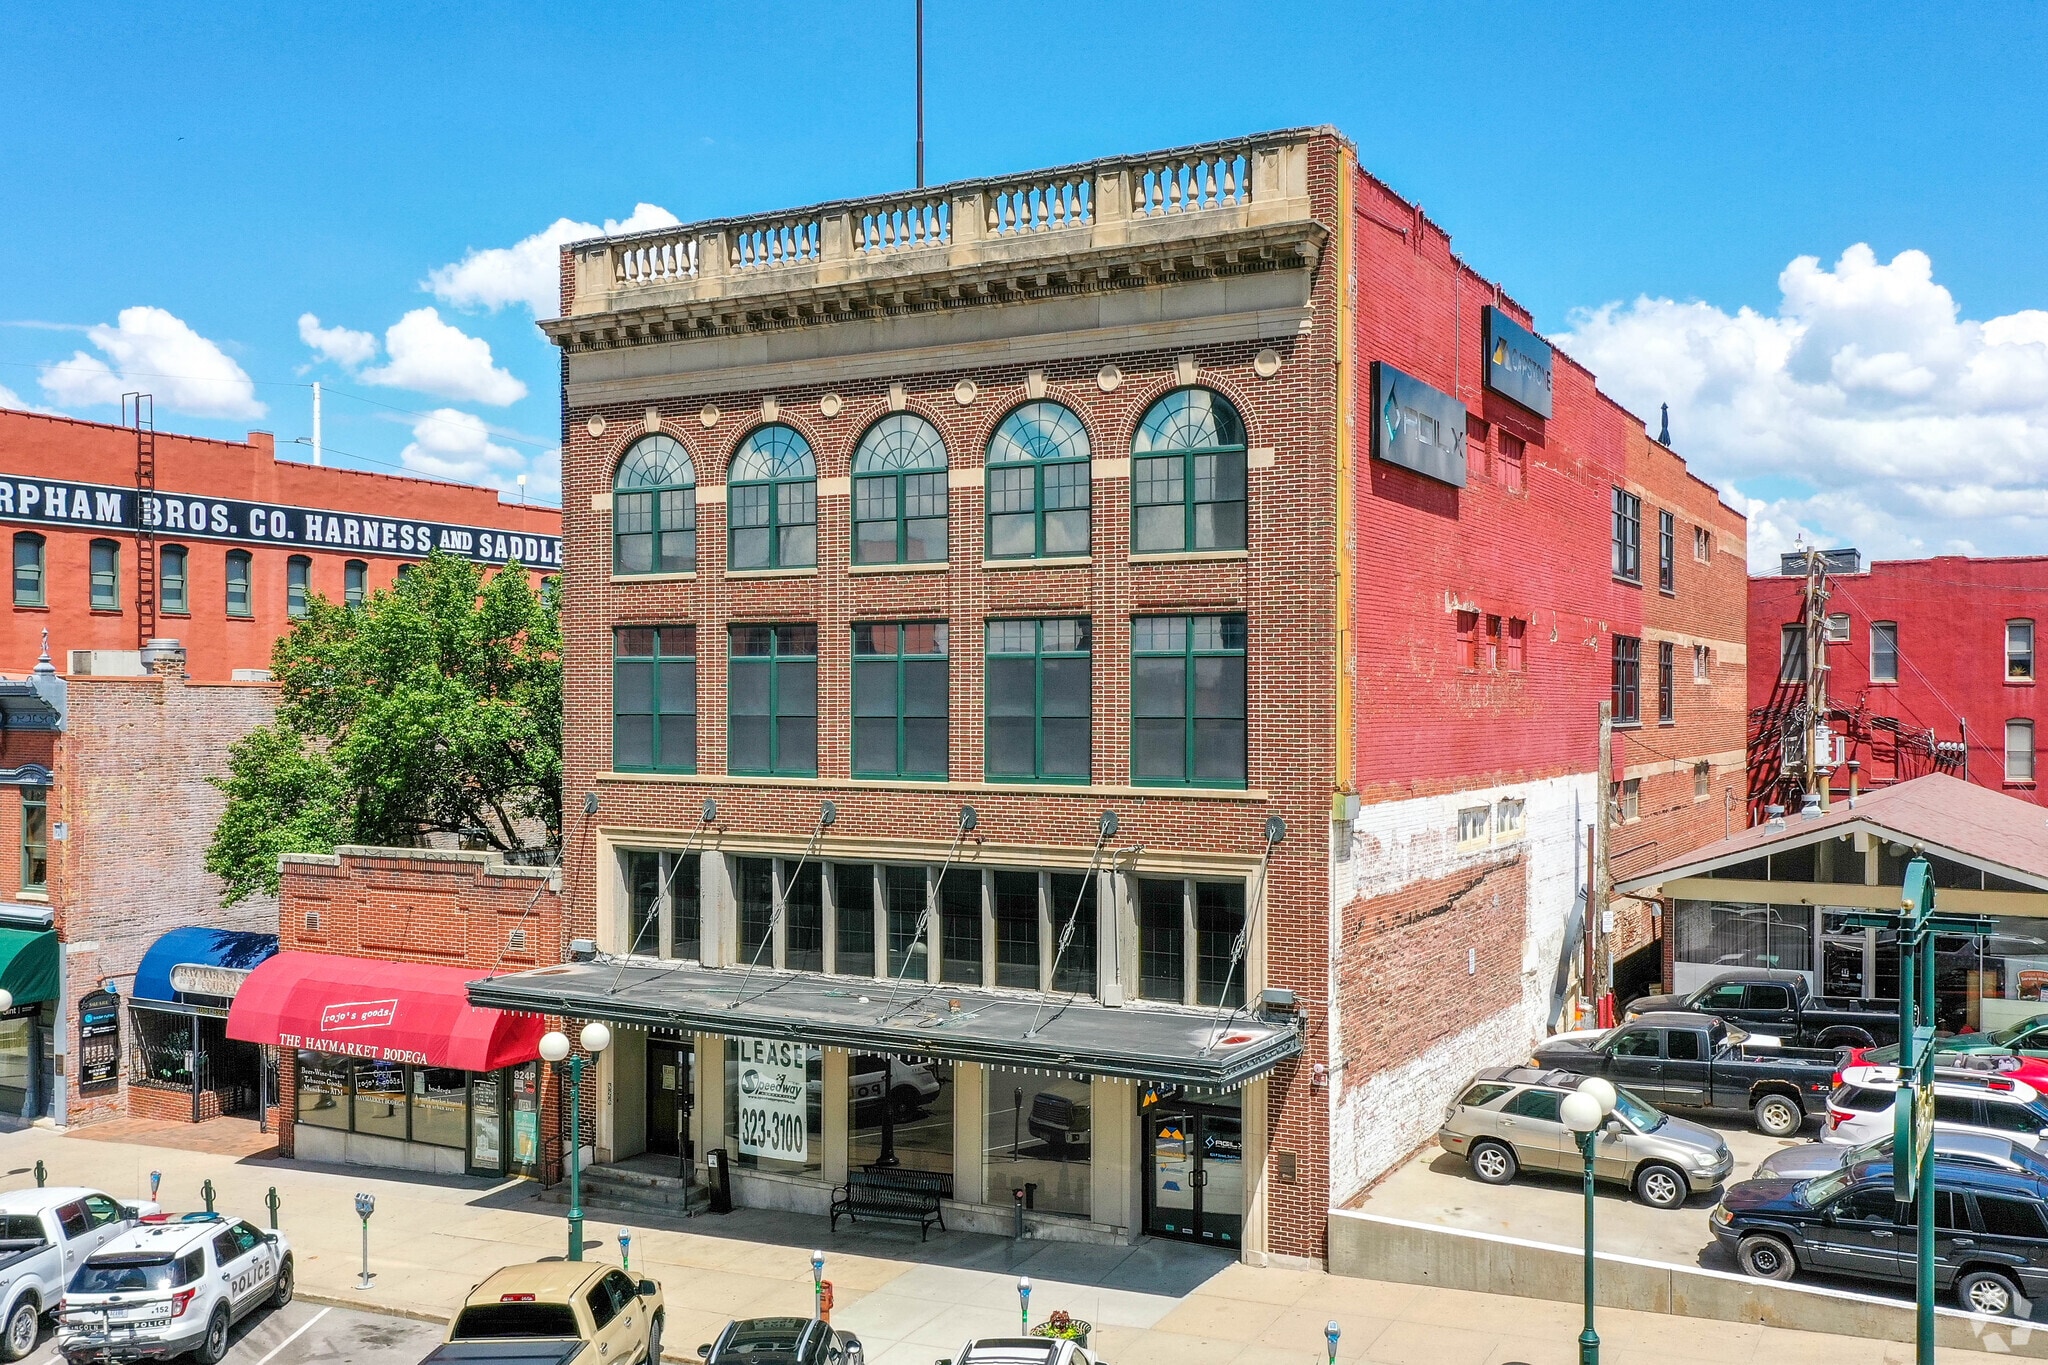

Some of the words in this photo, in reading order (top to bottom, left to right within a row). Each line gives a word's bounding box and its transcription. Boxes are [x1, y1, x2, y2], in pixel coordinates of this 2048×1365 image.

[142, 497, 237, 533] BROS.
[250, 508, 294, 539] CO.
[305, 514, 431, 551] HARNESS
[440, 529, 472, 550] AND
[324, 1011, 356, 1023] rojo's
[361, 1008, 392, 1021] goods.
[279, 1033, 301, 1047] THE
[305, 1037, 378, 1058] HAYMARKET
[383, 1047, 427, 1064] BODEGA
[741, 1039, 803, 1069] LEASE
[514, 1070, 536, 1080] 824P
[741, 1069, 802, 1100] Speedway
[742, 1107, 802, 1153] 323-3100
[232, 1261, 270, 1298] POLICE
[134, 1319, 172, 1329] POLICE
[156, 1306, 169, 1314] 152
